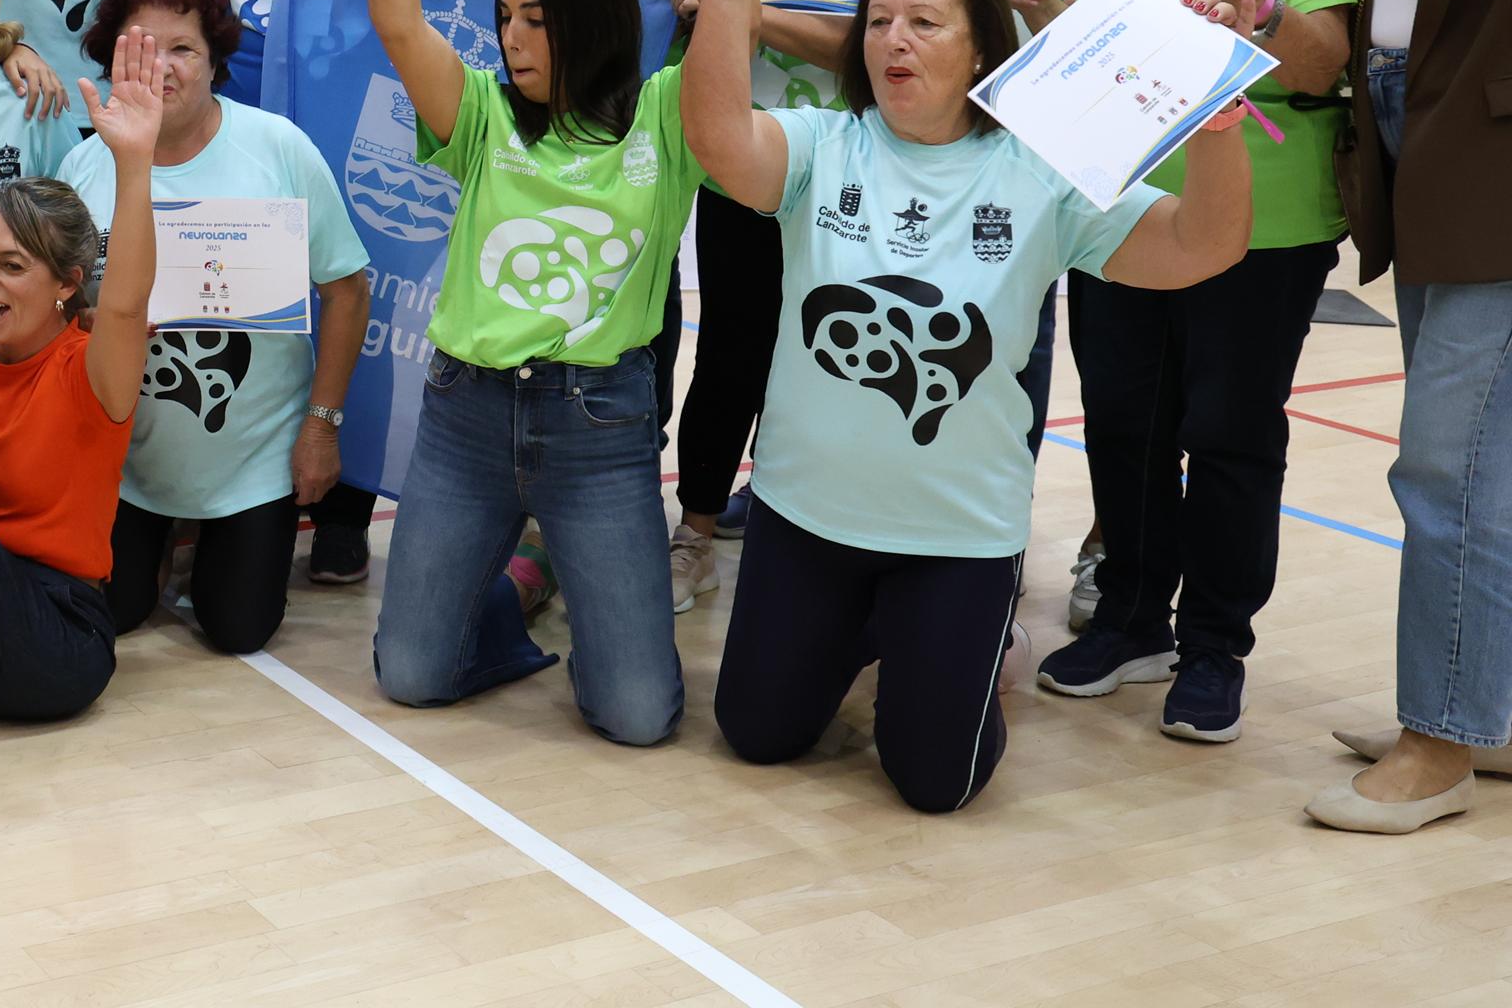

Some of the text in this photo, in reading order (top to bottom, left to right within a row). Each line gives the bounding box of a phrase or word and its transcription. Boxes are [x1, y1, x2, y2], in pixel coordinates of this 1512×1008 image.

[493, 159, 537, 176] Lanzarote
[818, 205, 871, 233] Cabdo de
[816, 217, 868, 243] Lanzarote
[205, 244, 221, 252] 2025
